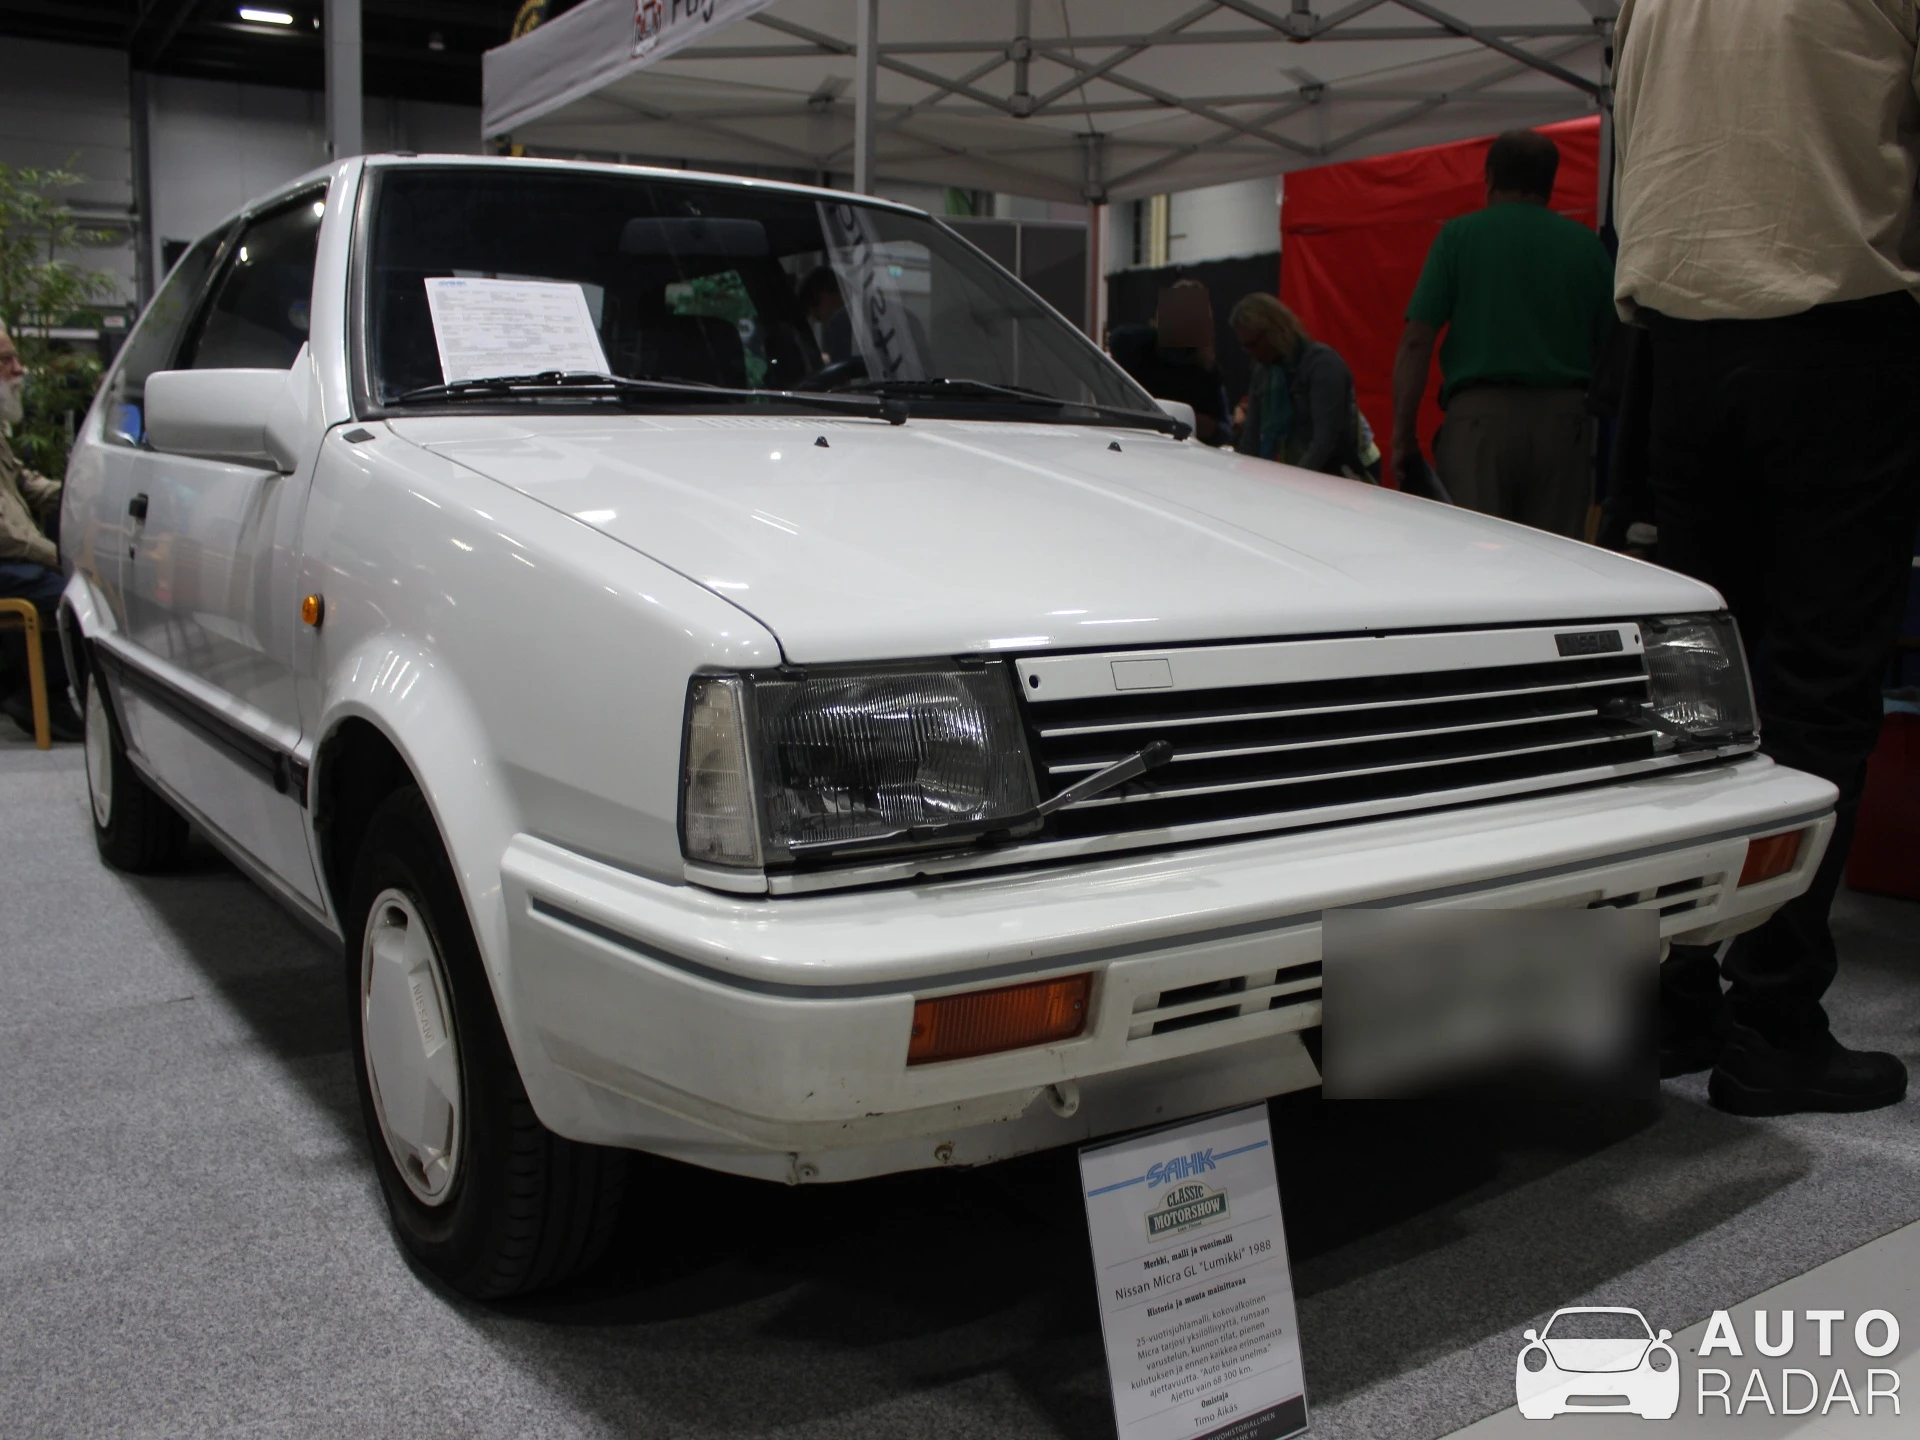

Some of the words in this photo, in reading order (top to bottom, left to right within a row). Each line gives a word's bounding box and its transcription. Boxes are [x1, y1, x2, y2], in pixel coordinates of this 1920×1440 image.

[412, 983, 435, 1043] NISSAN
[1146, 1148, 1216, 1188] SAHK
[1153, 1197, 1220, 1231] MOTORSHOW
[1166, 1185, 1204, 1207] CLASSIC
[1115, 1282, 1150, 1301] Nissan
[1153, 1272, 1181, 1288] Micra
[1183, 1265, 1198, 1278] GL
[1199, 1247, 1245, 1271] "Lumikki"
[1248, 1239, 1271, 1256] 1988
[1143, 1255, 1170, 1270] Merkki,
[1171, 1248, 1189, 1261] malli
[1191, 1246, 1198, 1257] ja
[1199, 1234, 1233, 1252] vuosimalli
[1146, 1302, 1174, 1317] Historia
[1175, 1299, 1183, 1309] ja
[1184, 1291, 1206, 1304] muuta
[1207, 1278, 1246, 1296] mainittavaa
[1212, 1295, 1266, 1319] kokovalkoinen
[1137, 1347, 1160, 1361] Micra
[1161, 1338, 1186, 1352] tarjosi
[1240, 1307, 1270, 1322] runsaan
[1146, 1350, 1189, 1371] varustelun,
[1190, 1338, 1219, 1354] kunnon
[1220, 1331, 1238, 1343] tilat,
[1239, 1321, 1265, 1338] pienen
[1130, 1370, 1174, 1390] kulutuksen
[1175, 1365, 1183, 1375] ja
[1184, 1355, 1208, 1370] ennen
[1209, 1344, 1238, 1360] kaikkea
[1239, 1328, 1282, 1349] erinomaista
[1149, 1373, 1199, 1398] ajettavuutta.
[1221, 1357, 1238, 1369] kuin
[1170, 1388, 1194, 1403] Ajettu
[1196, 1382, 1212, 1393] vain
[1213, 1375, 1222, 1385] 68
[1224, 1370, 1237, 1381] 300
[1201, 1391, 1229, 1408] Omistaja
[1194, 1413, 1215, 1427] Timo
